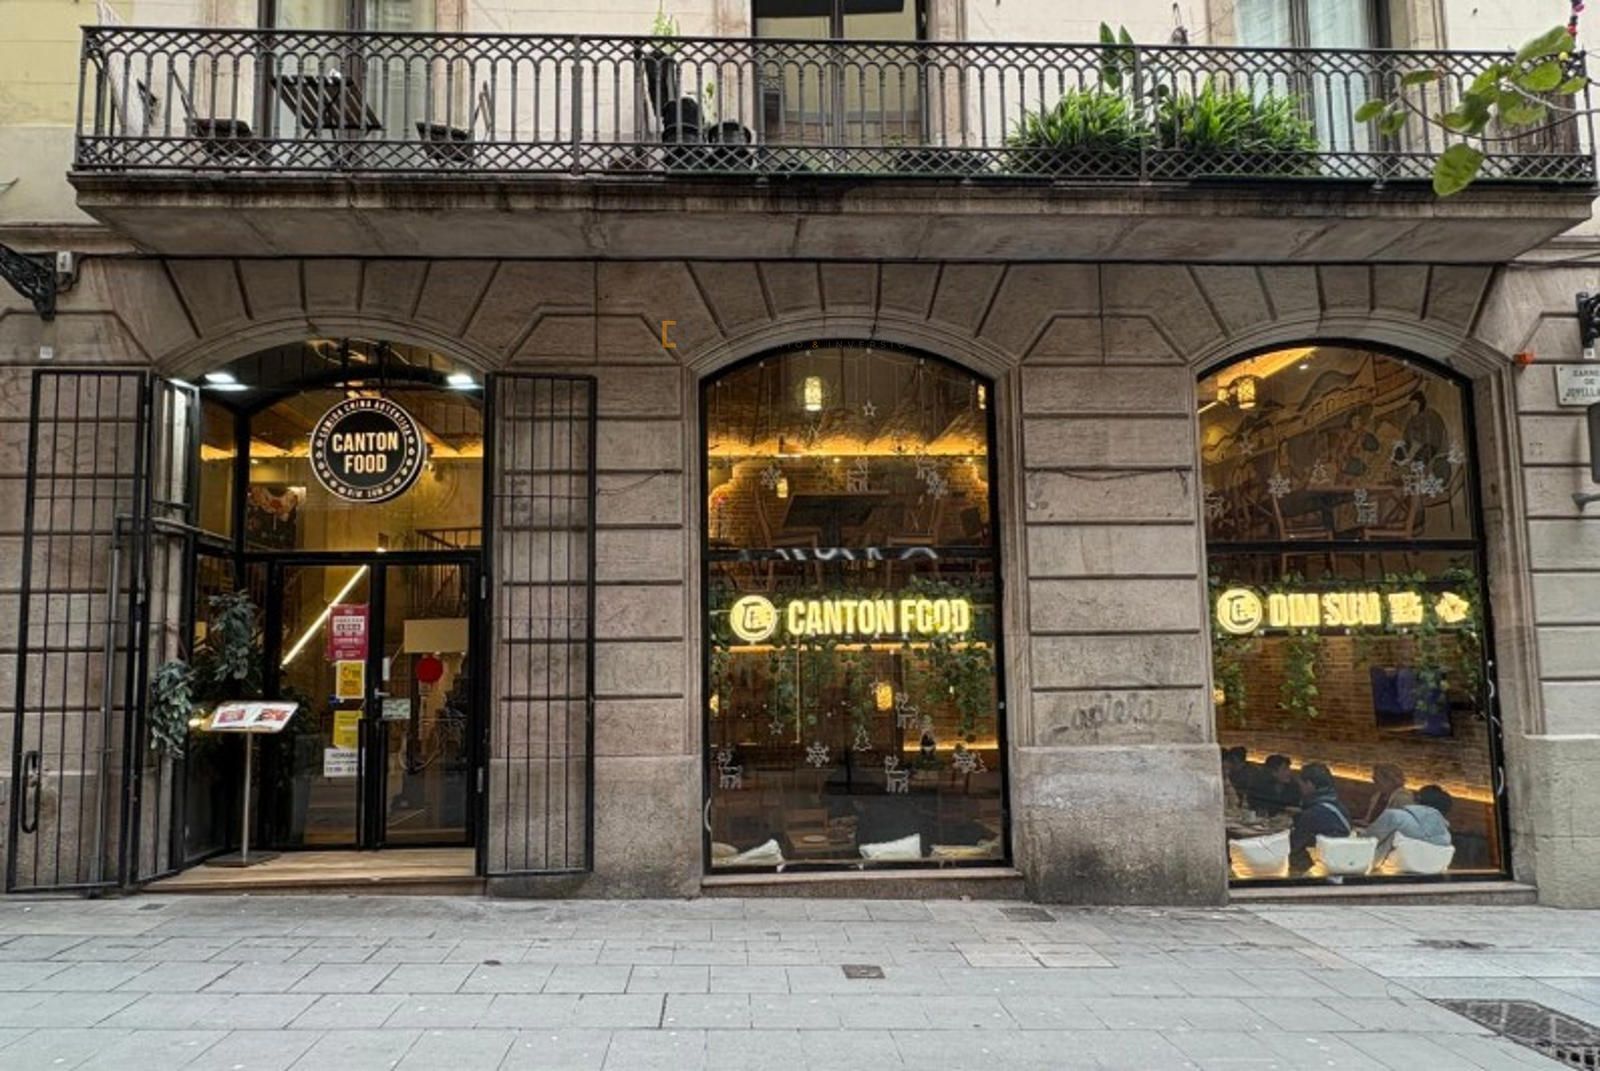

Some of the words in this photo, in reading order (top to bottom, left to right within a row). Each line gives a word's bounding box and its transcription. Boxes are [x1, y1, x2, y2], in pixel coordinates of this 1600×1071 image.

[332, 431, 399, 453] CANTON
[344, 453, 387, 475] FOOD
[788, 599, 895, 636] CANTON
[901, 598, 970, 635] FOOD
[1268, 592, 1321, 627] DIM
[1323, 591, 1382, 626] SUM
